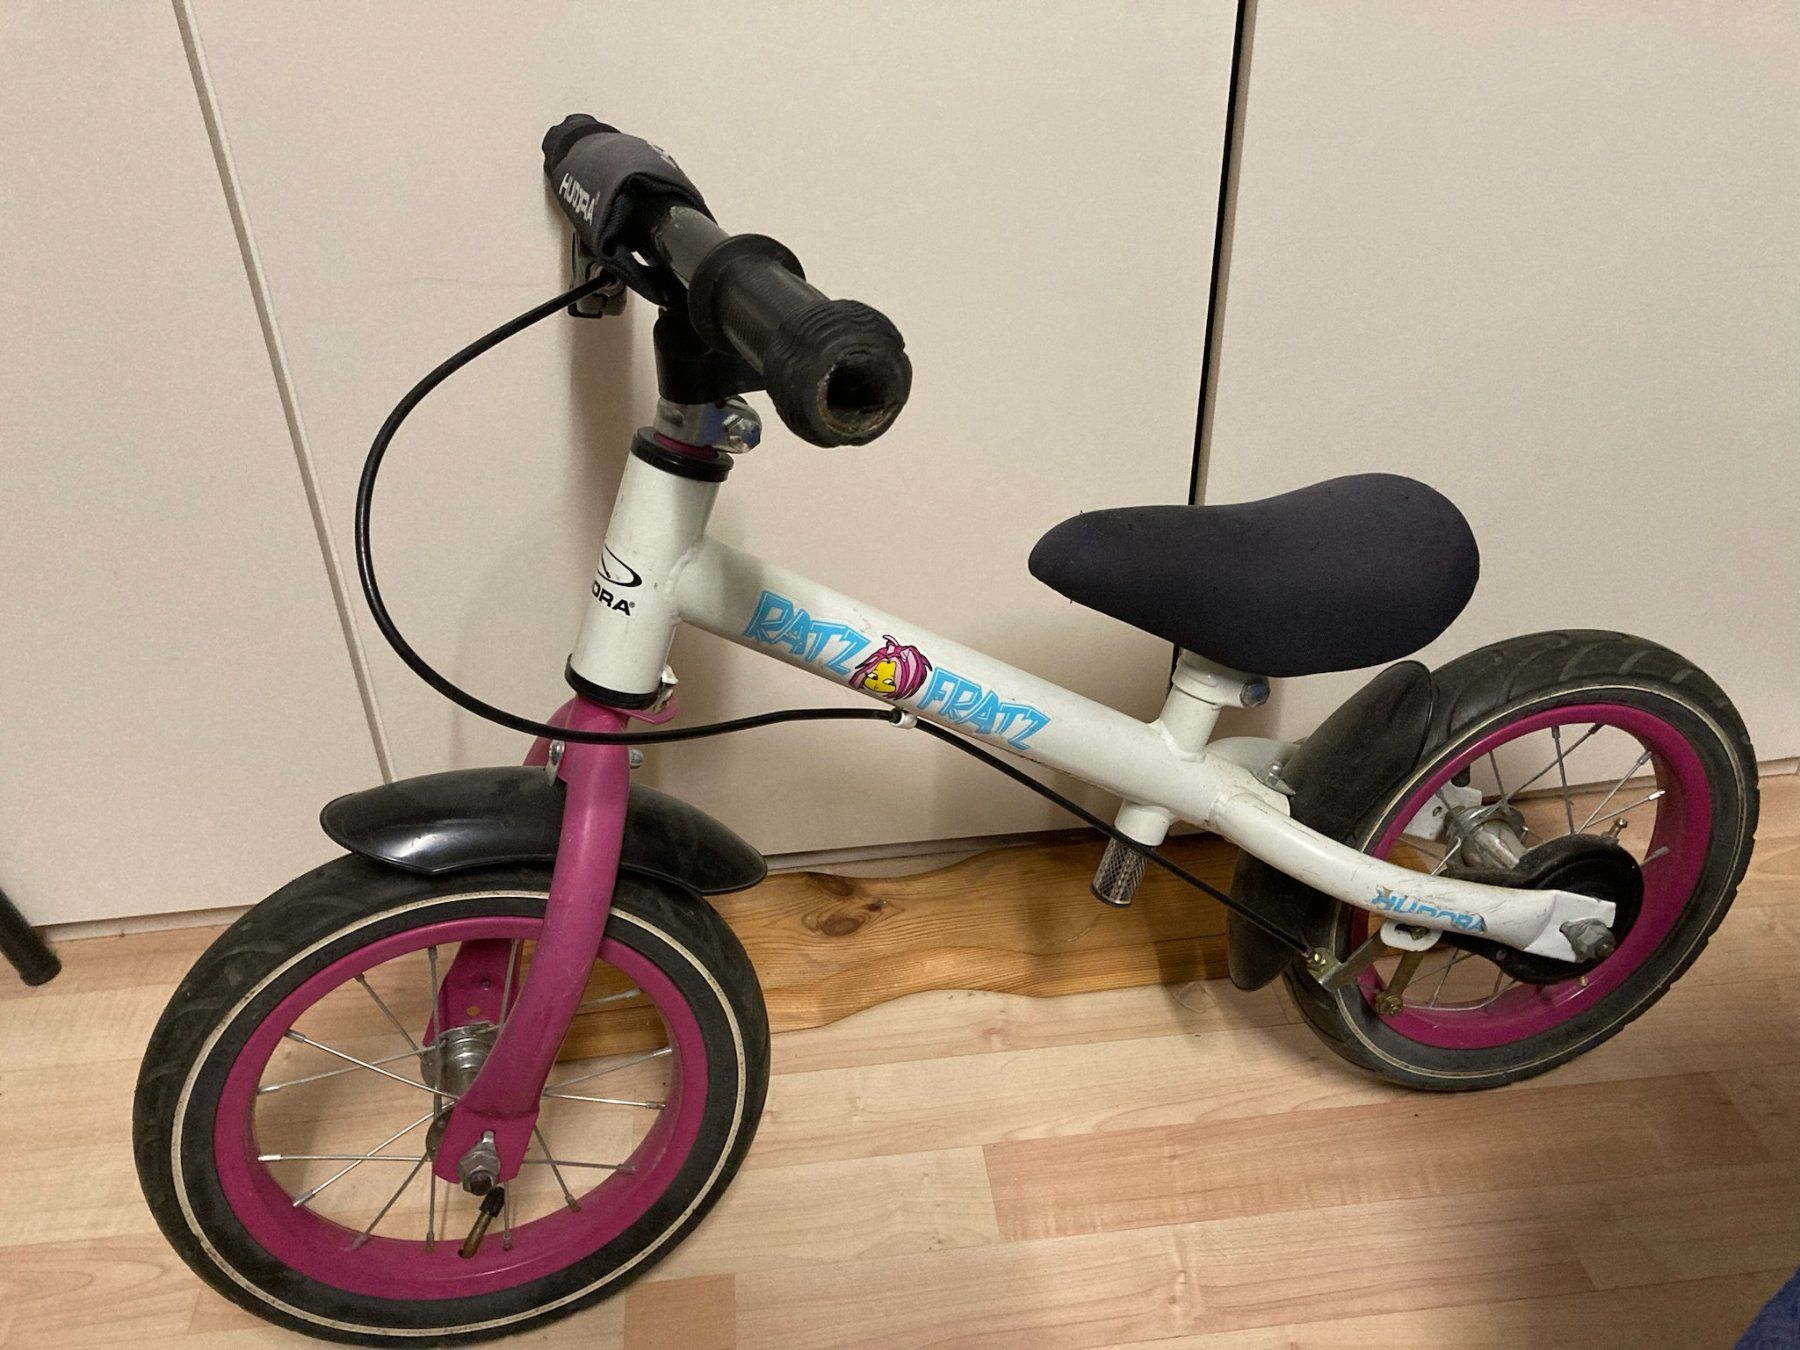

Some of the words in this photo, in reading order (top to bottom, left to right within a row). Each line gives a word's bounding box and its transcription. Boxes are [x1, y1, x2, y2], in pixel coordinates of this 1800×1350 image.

[559, 173, 596, 226] HUDORA
[742, 590, 871, 675] RATZ
[917, 666, 1051, 750] FRATZ
